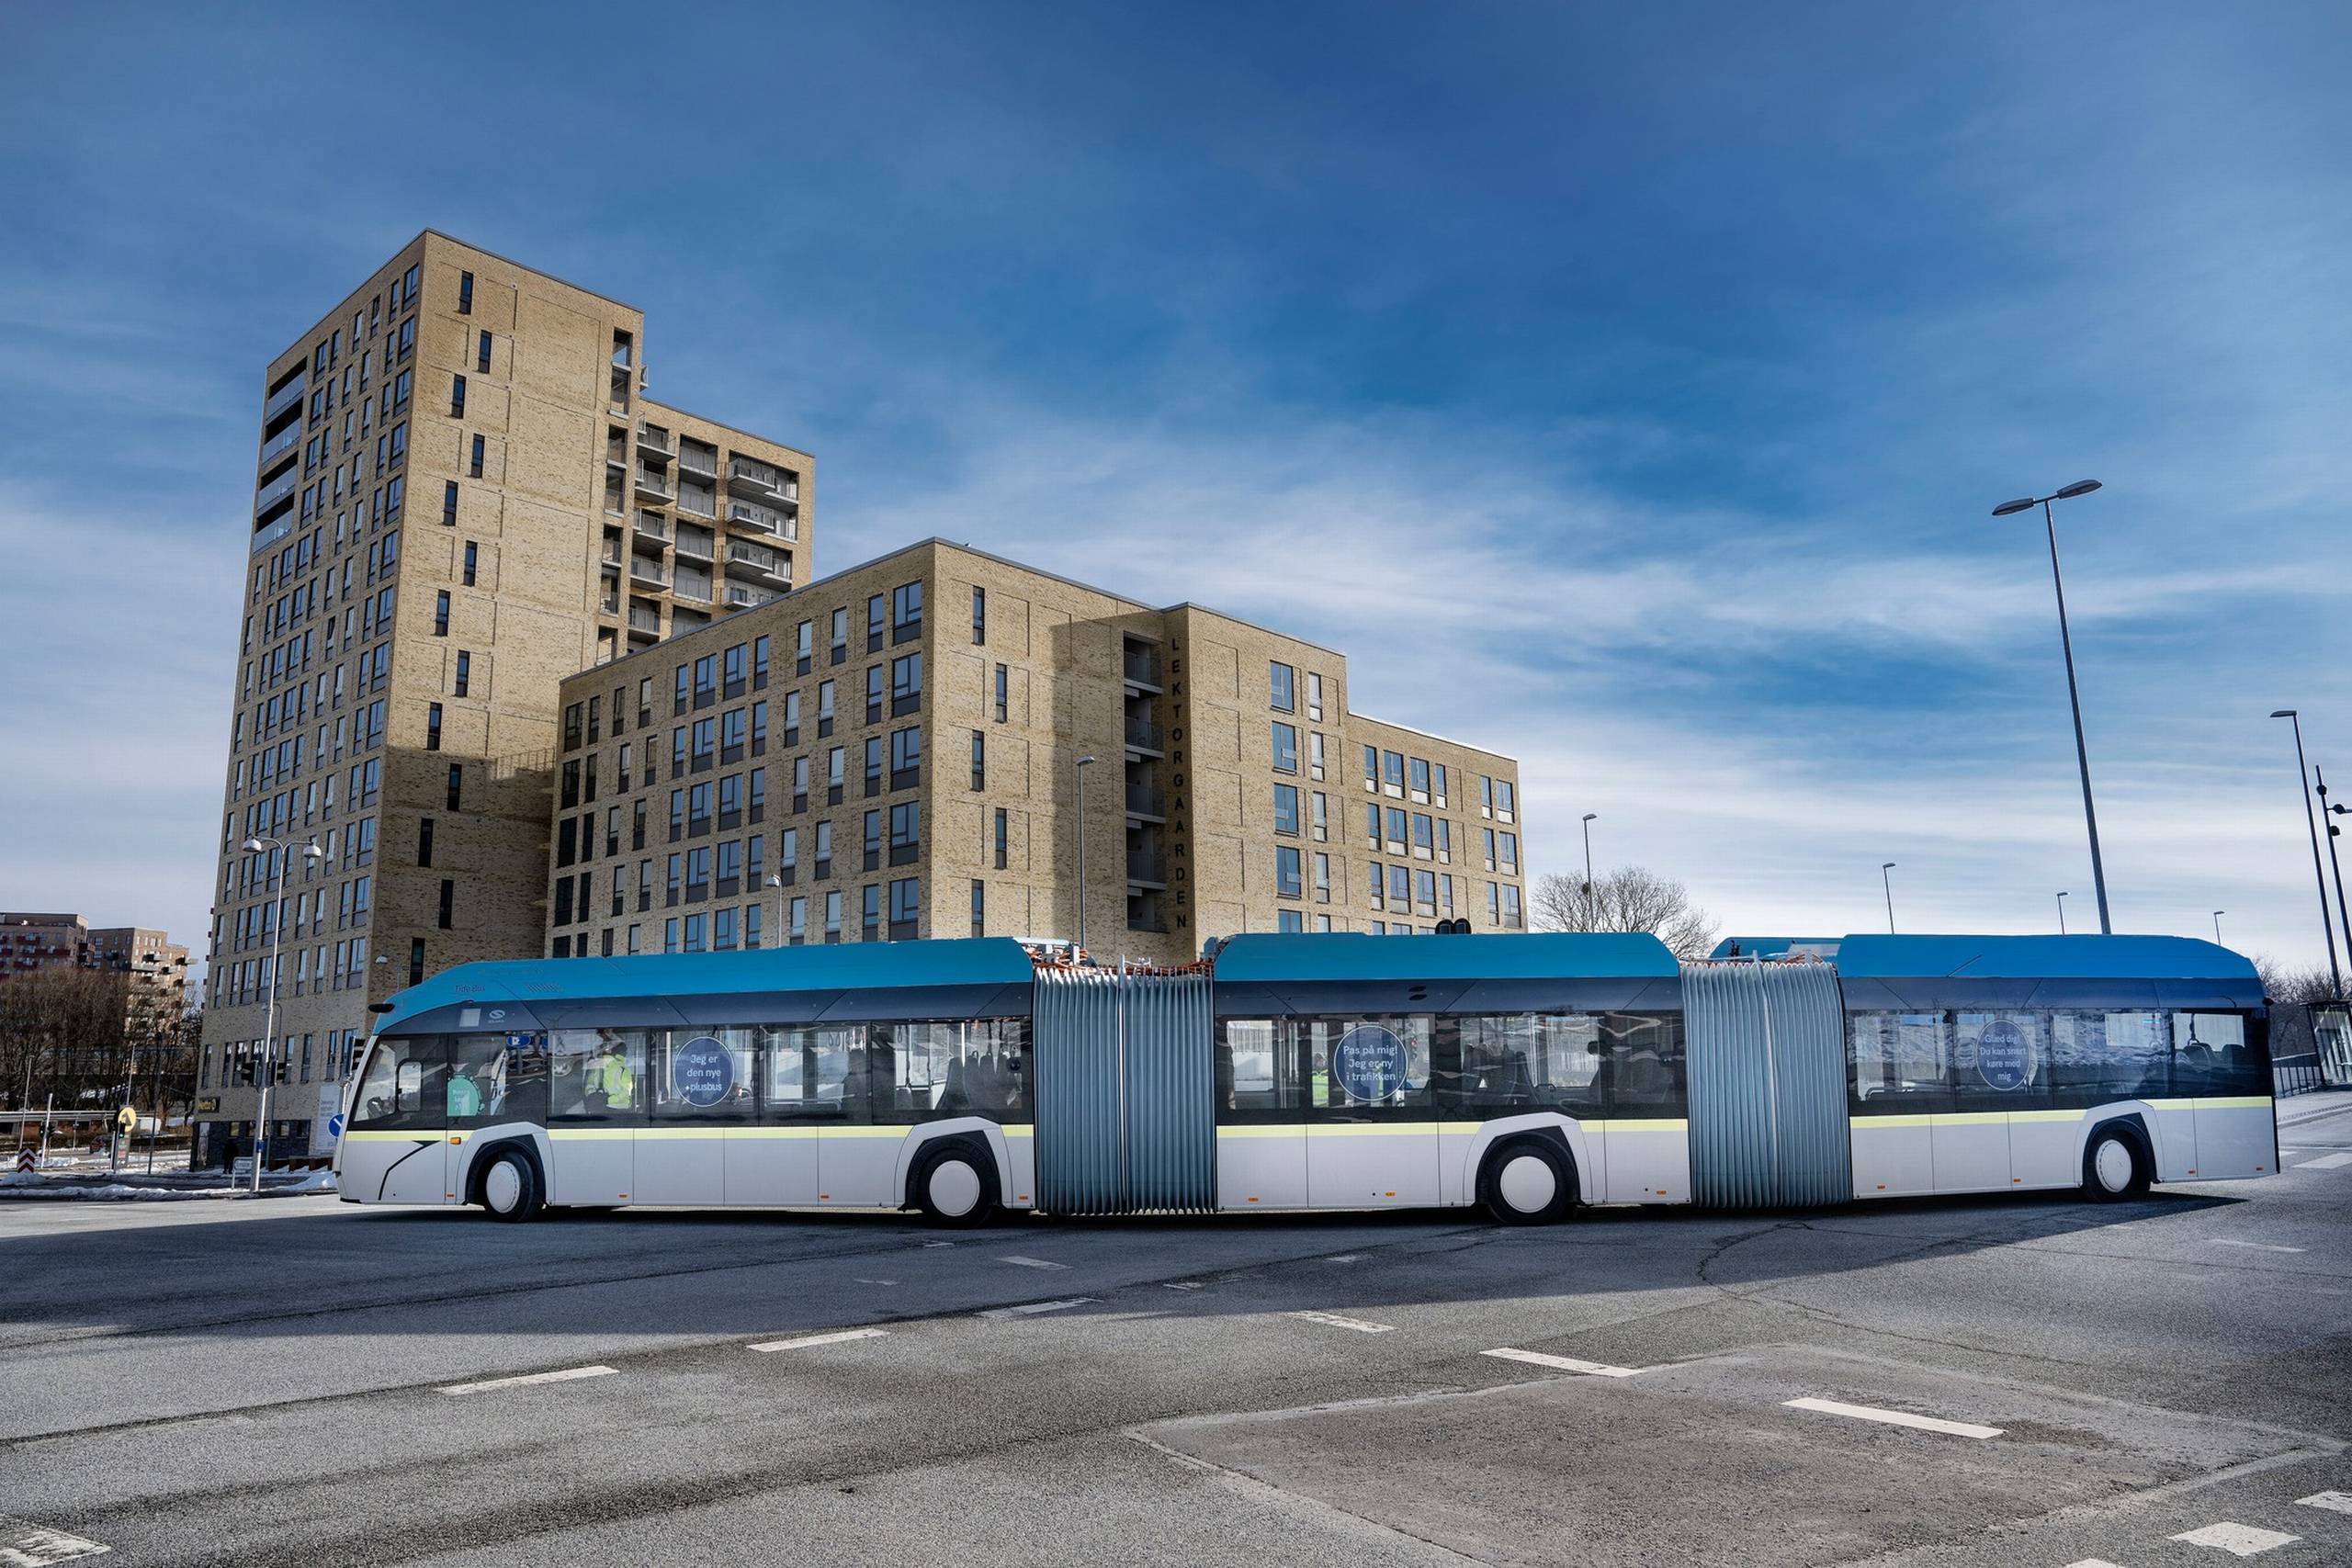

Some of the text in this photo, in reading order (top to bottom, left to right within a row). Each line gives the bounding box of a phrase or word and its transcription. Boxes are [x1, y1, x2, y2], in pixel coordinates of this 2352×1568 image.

[1170, 637, 1187, 930] LEKTORGAARDEN
[1343, 1044, 1397, 1056] Pas på mig!
[1991, 1047, 2006, 1055] kan
[690, 1055, 718, 1066] Jeg er
[1349, 1059, 1394, 1070] Jeg er ny
[2004, 1059, 2021, 1067] med
[686, 1068, 721, 1079] den nye
[1351, 1072, 1396, 1081] trafikken
[1997, 1072, 2012, 1082] mig
